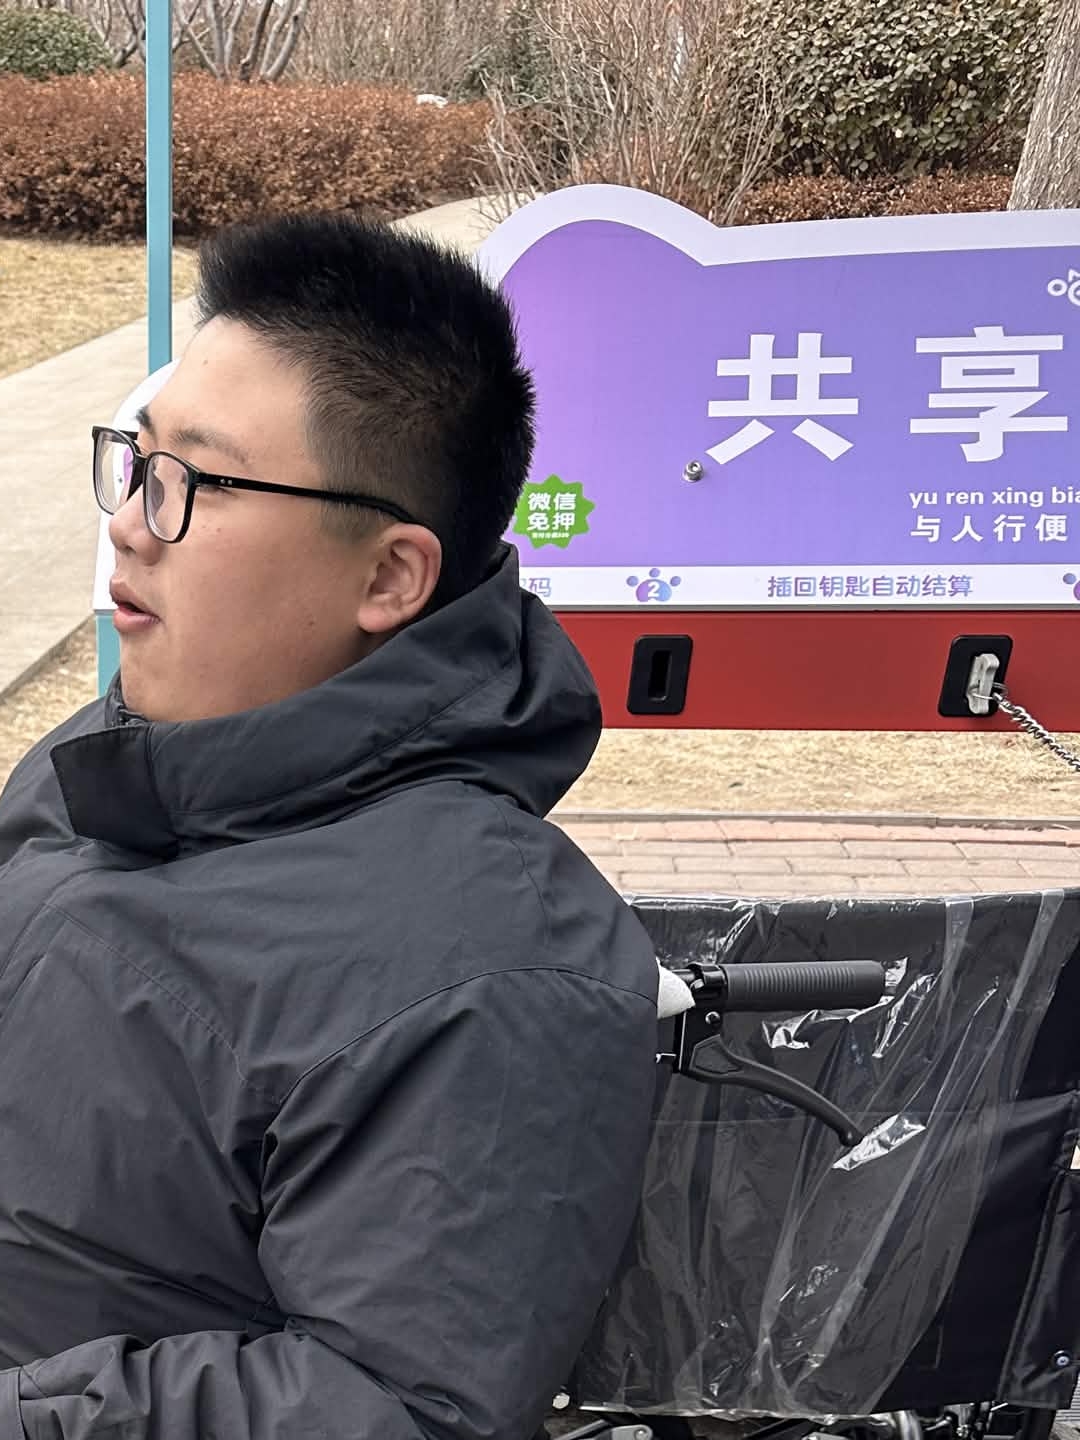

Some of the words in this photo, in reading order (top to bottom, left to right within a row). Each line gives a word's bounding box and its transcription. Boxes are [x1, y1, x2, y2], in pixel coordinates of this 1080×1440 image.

[705, 326, 1068, 465] 共享
[527, 492, 577, 511] 微信
[909, 491, 938, 509] yu
[946, 490, 984, 505] ren
[992, 486, 1044, 508] xing
[526, 512, 576, 531] 免押
[910, 514, 1068, 542] 与人行便
[520, 577, 552, 598] 码
[647, 581, 660, 598] 2
[767, 575, 974, 598] 插回钥匙自动结算
